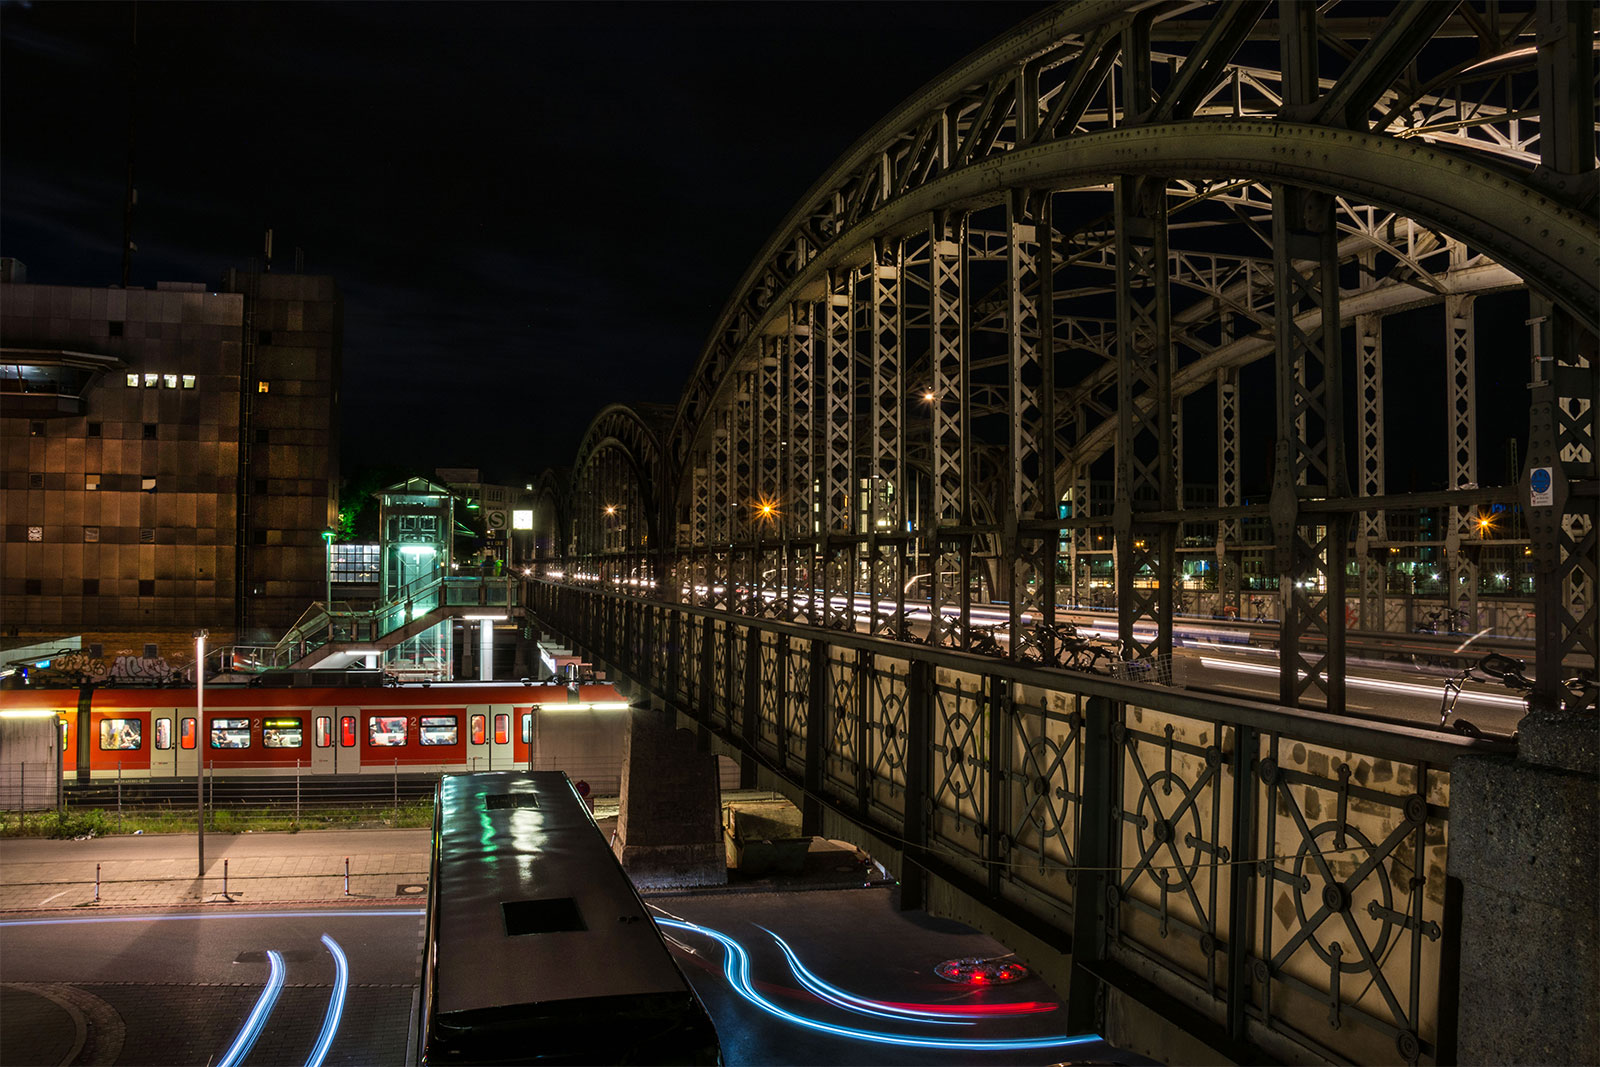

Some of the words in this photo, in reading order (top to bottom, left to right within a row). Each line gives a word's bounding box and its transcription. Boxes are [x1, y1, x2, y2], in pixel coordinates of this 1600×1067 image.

[489, 511, 505, 528] S
[253, 718, 260, 728] 2
[410, 716, 417, 726] 2
